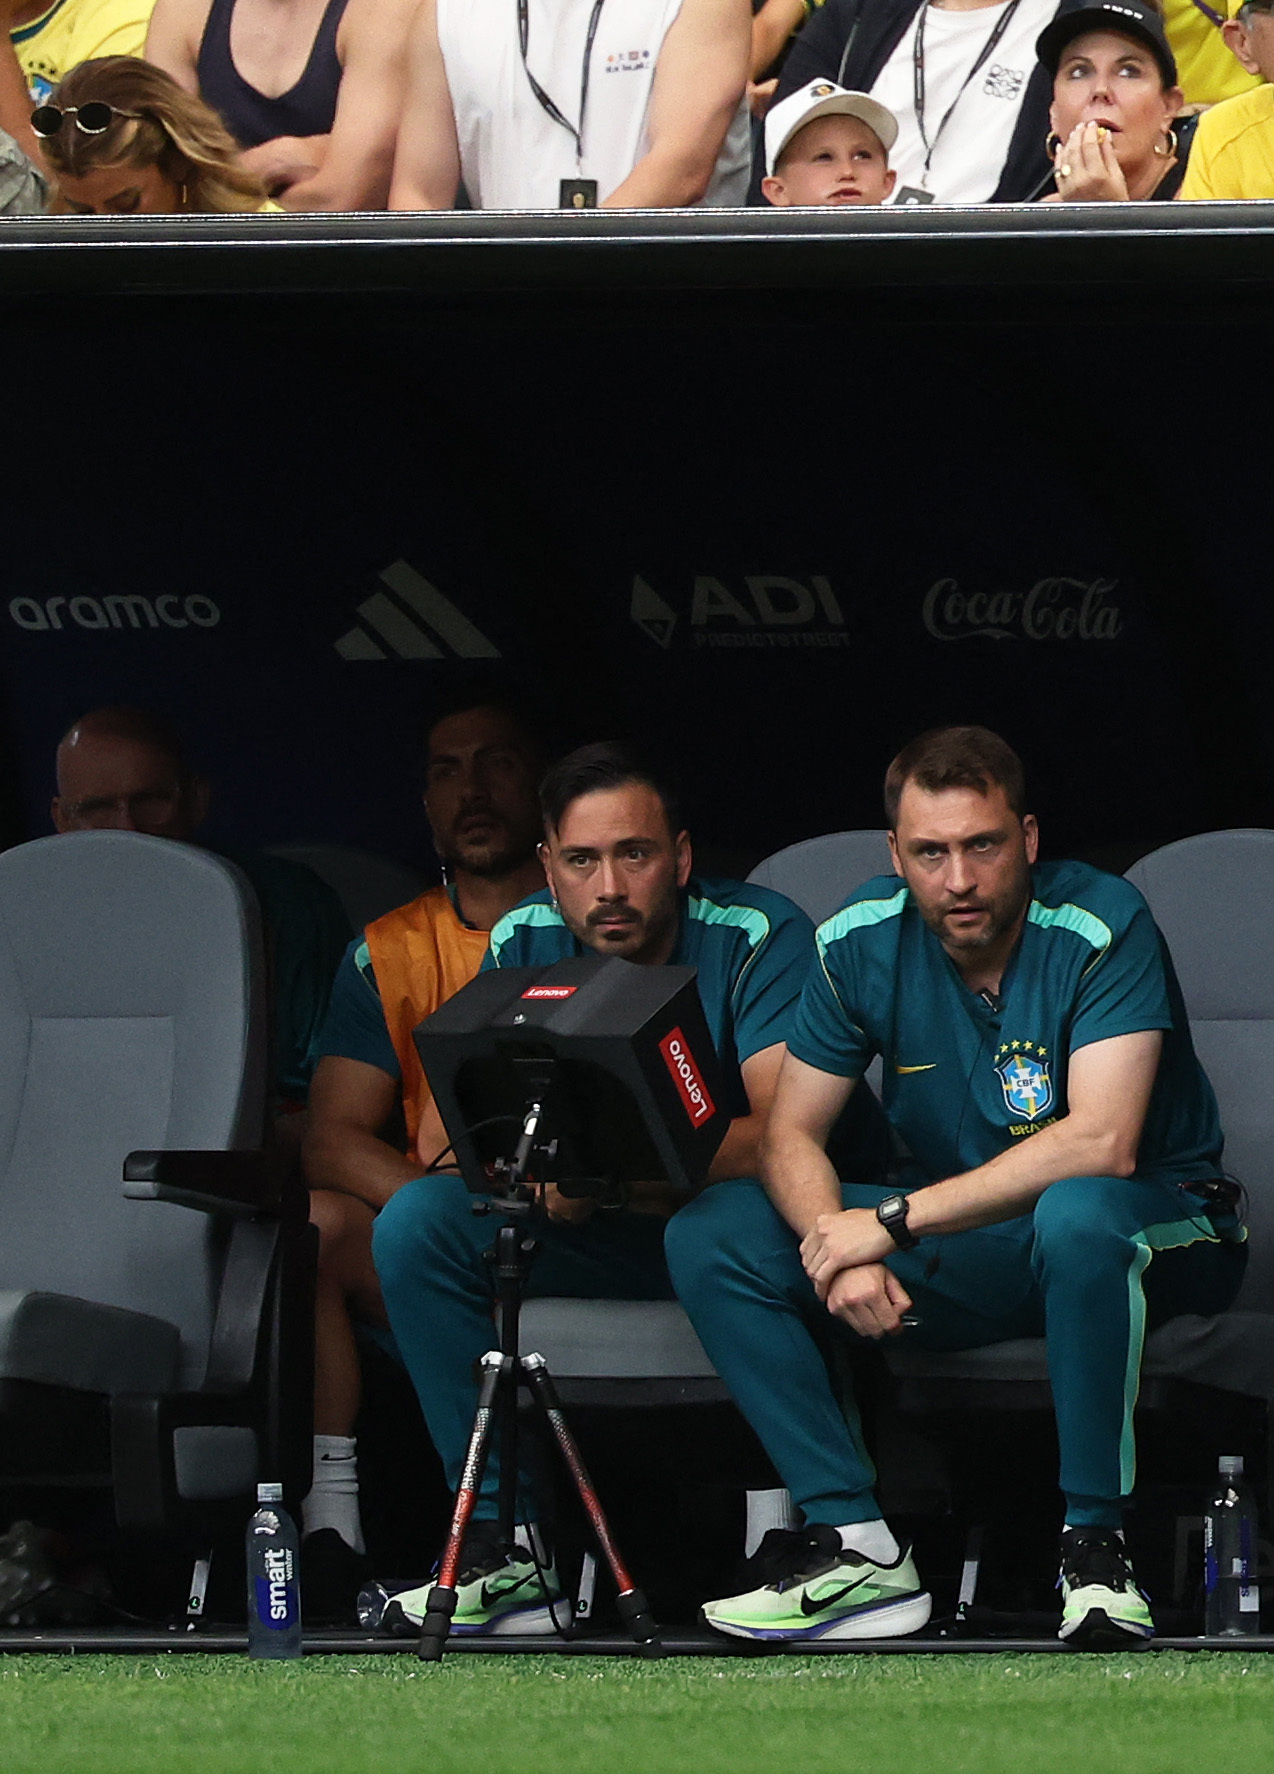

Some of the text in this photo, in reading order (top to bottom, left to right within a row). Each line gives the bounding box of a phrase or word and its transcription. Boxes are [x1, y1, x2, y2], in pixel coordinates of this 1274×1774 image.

[9, 594, 221, 631] aramco
[691, 575, 845, 625] ADI
[527, 988, 569, 997] Lenovo
[669, 1039, 708, 1118] Lenovo
[1016, 1078, 1035, 1088] CBF
[285, 1548, 294, 1581] water
[265, 1548, 288, 1620] smart
